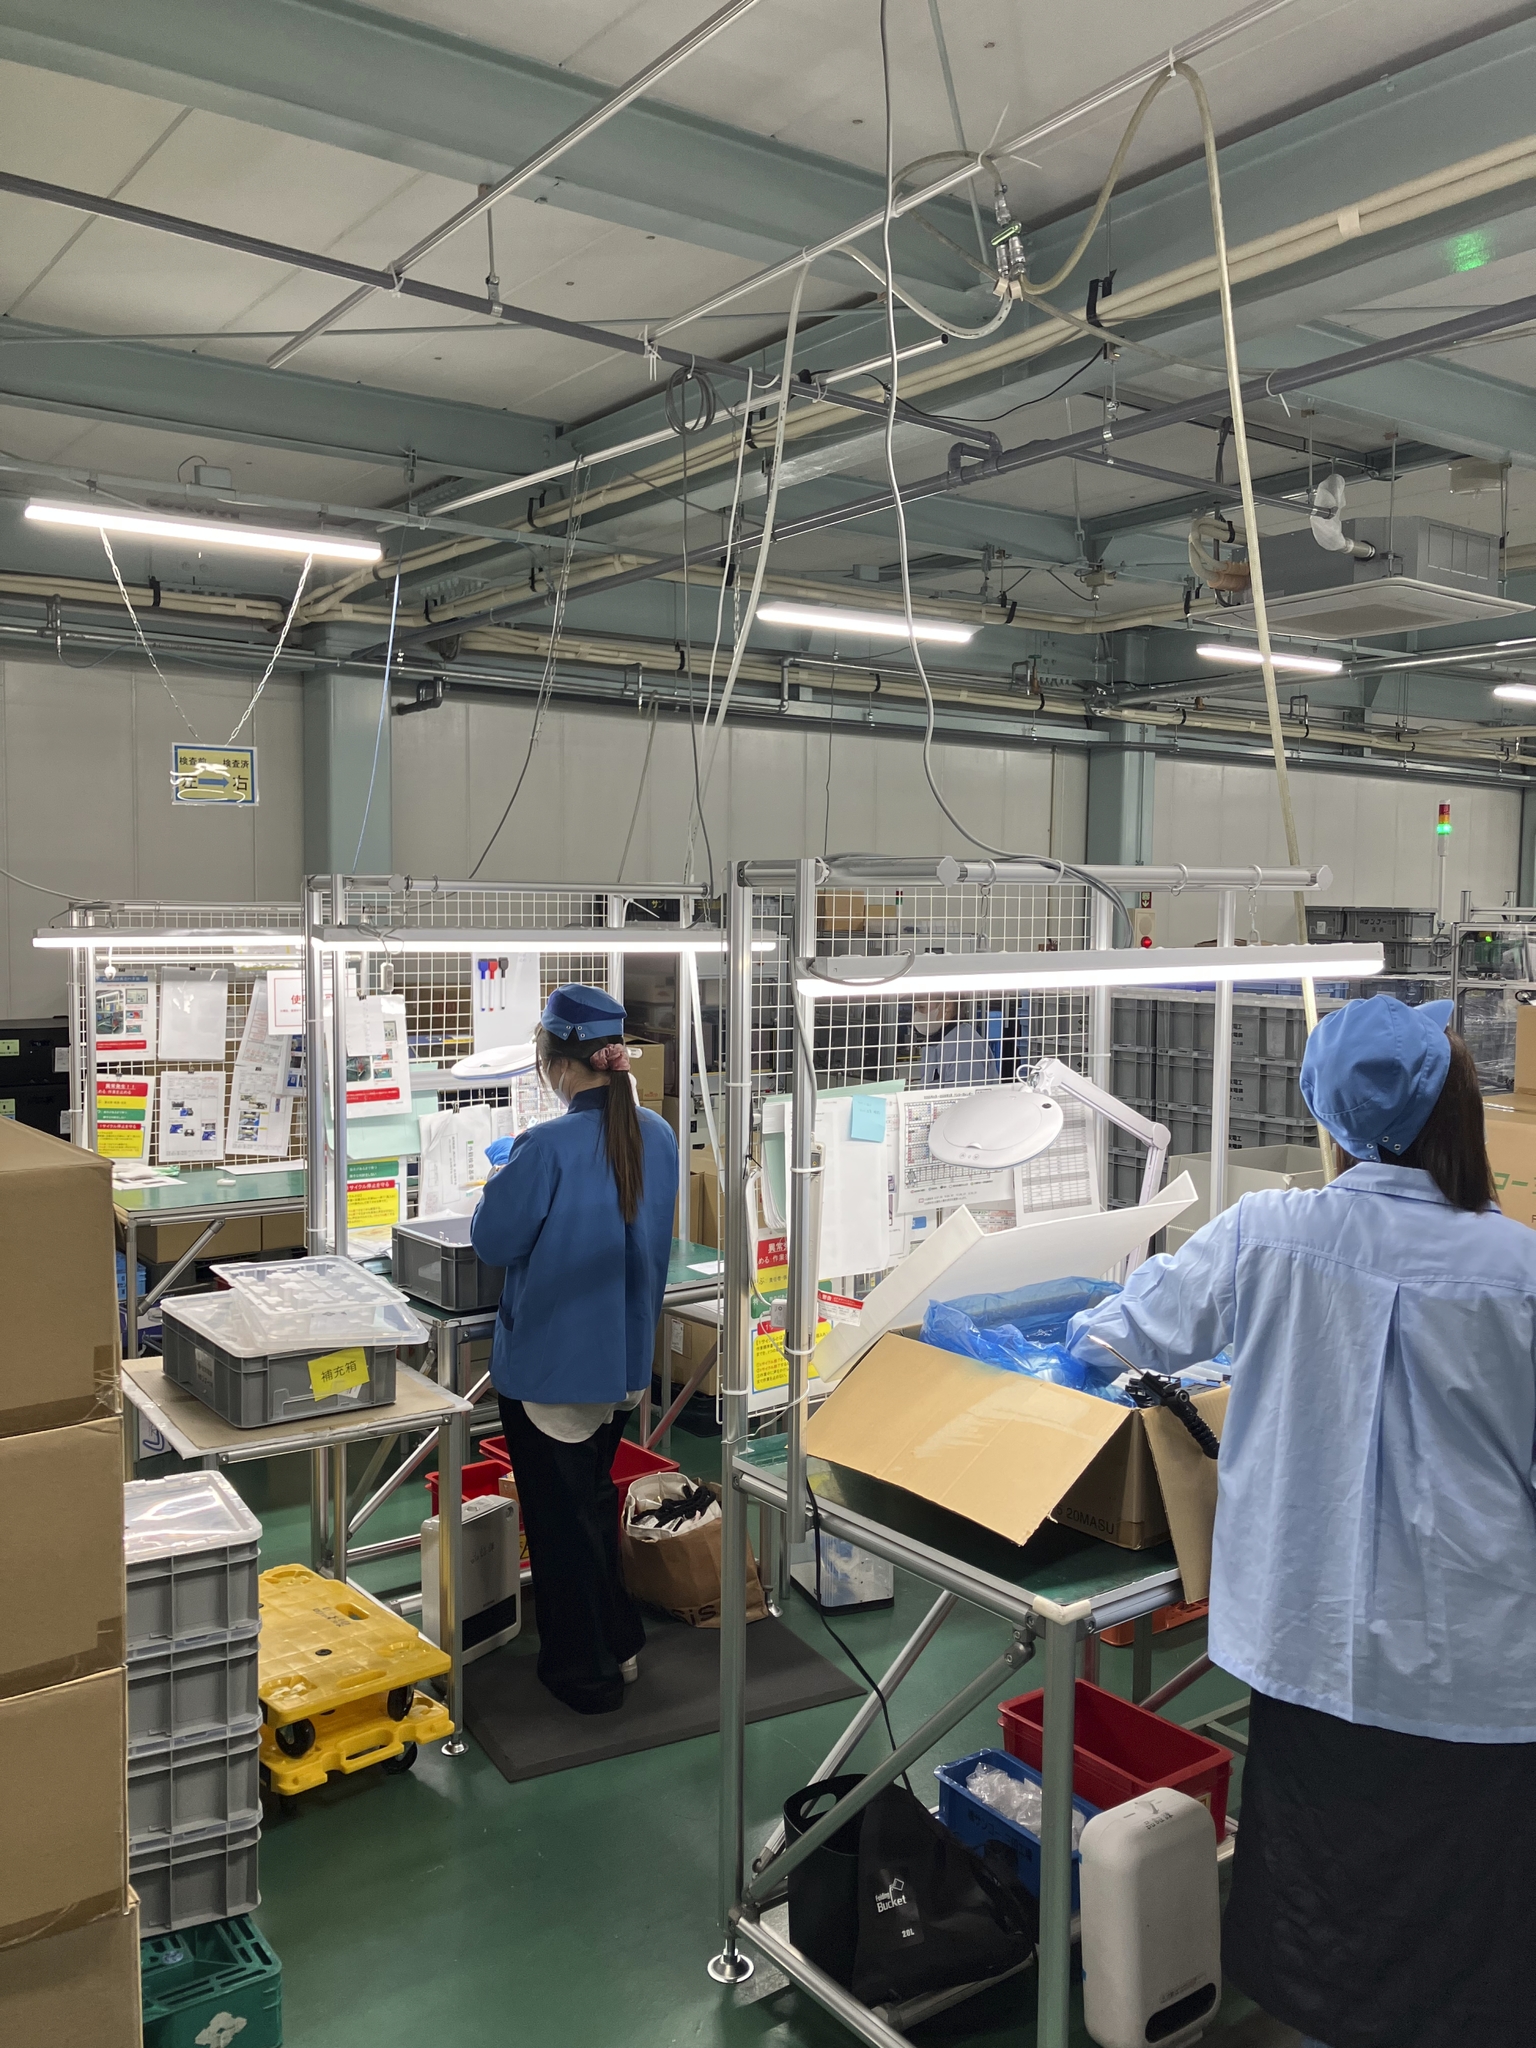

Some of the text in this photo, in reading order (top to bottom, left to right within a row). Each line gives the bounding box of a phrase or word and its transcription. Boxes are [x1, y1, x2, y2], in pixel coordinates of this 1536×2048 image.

[223, 758, 249, 769] 検査済
[232, 775, 249, 791] 右
[321, 1360, 357, 1383] 補充箱
[1066, 1507, 1115, 1535] 20MASU
[876, 1891, 907, 1913] Bucket
[901, 1928, 915, 1938] 20L
